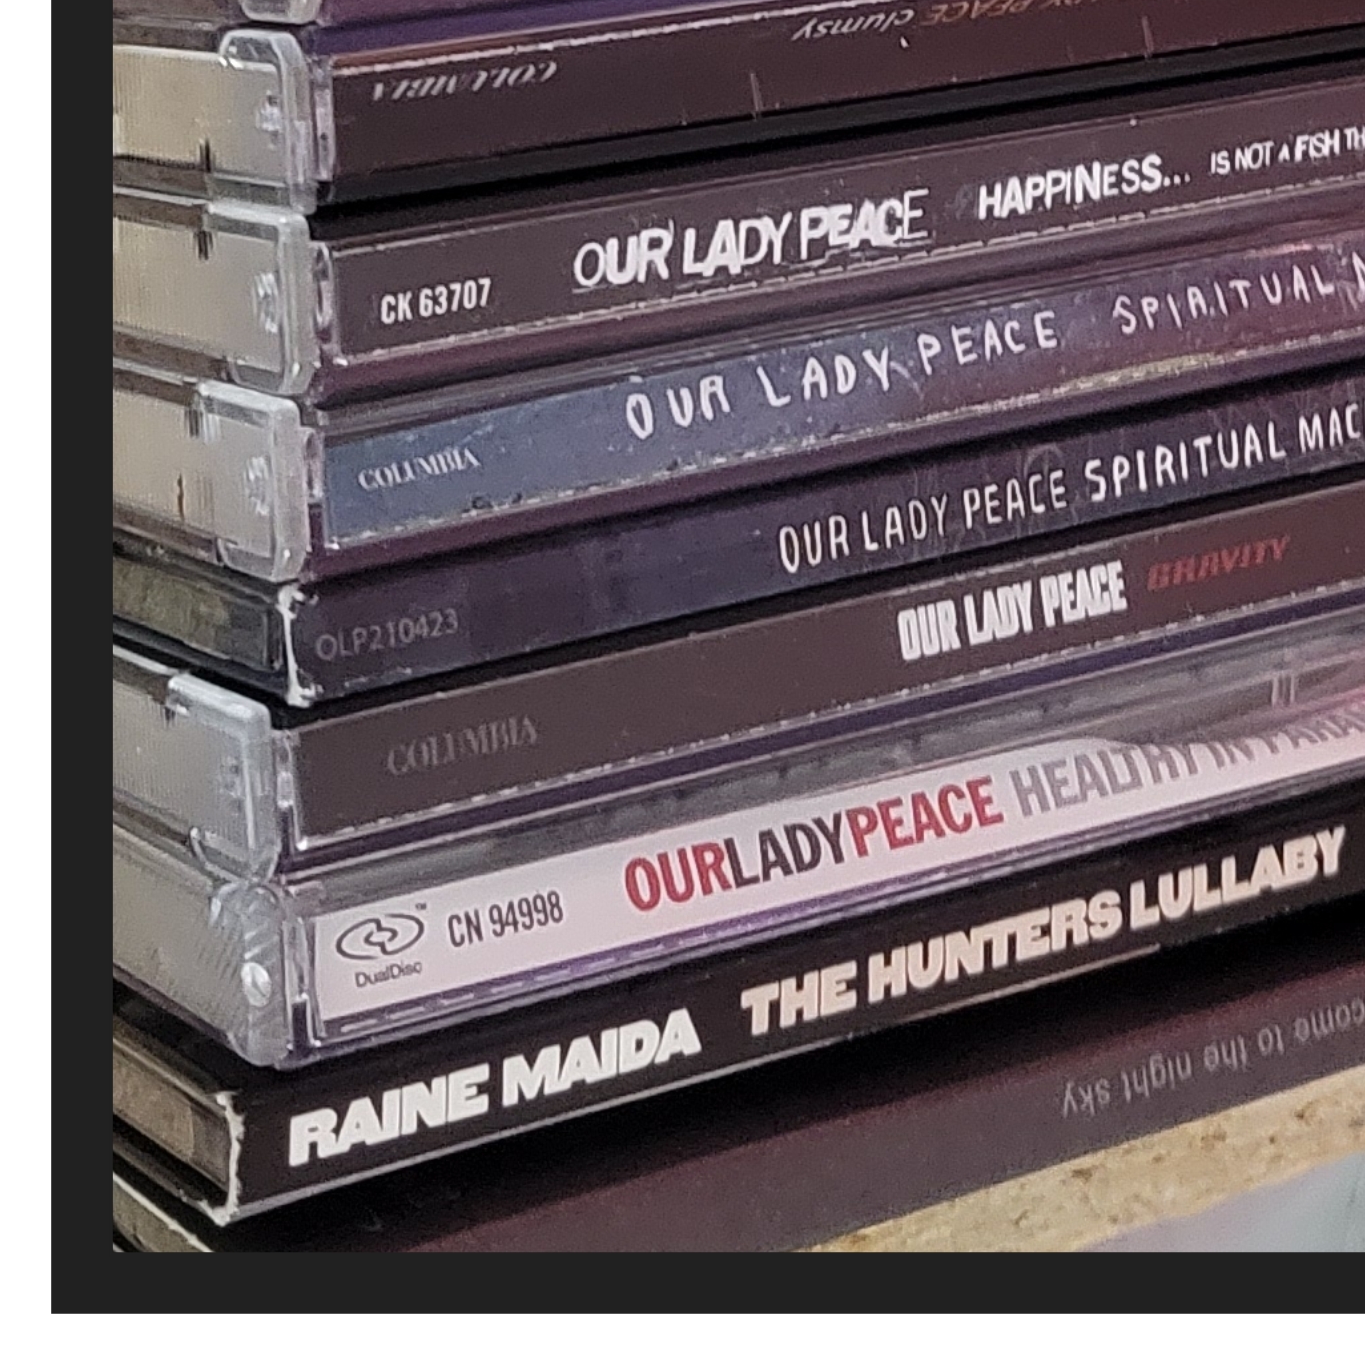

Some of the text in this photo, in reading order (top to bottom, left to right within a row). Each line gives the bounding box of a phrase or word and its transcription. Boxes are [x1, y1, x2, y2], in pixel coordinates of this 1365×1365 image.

[370, 6, 917, 102] clumsy COLUMBIA
[380, 288, 414, 326] CK
[418, 277, 492, 318] 63707
[977, 153, 1192, 221] HAPPINESS...
[1209, 147, 1232, 176] IS
[1233, 138, 1274, 172] NOT
[1293, 127, 1341, 163] FISH
[357, 444, 482, 493] COLUMBIA
[625, 374, 730, 442] OUR
[915, 309, 1060, 377] PEACE
[1112, 263, 1336, 337] SPIRITUAL
[313, 607, 460, 664] OLP210423
[777, 515, 851, 574] OUR
[860, 492, 953, 553] LADY
[962, 469, 1068, 531] PEACE
[1084, 421, 1286, 503] SPIRITUAL
[386, 533, 1293, 778] COLUMBIA OUR LADY PEACE GRAVITY
[447, 889, 565, 949] CN 94998
[286, 1066, 491, 1168] RAINE
[501, 1006, 703, 1109] MAIDA
[740, 966, 859, 1039] THE
[866, 893, 1127, 1008] HUNTERS
[1127, 823, 1347, 929] LULLABY
[353, 960, 422, 989] DualDisc
[1060, 1077, 1111, 1119] sky
[1120, 1051, 1193, 1104] night
[1203, 1034, 1249, 1074] the
